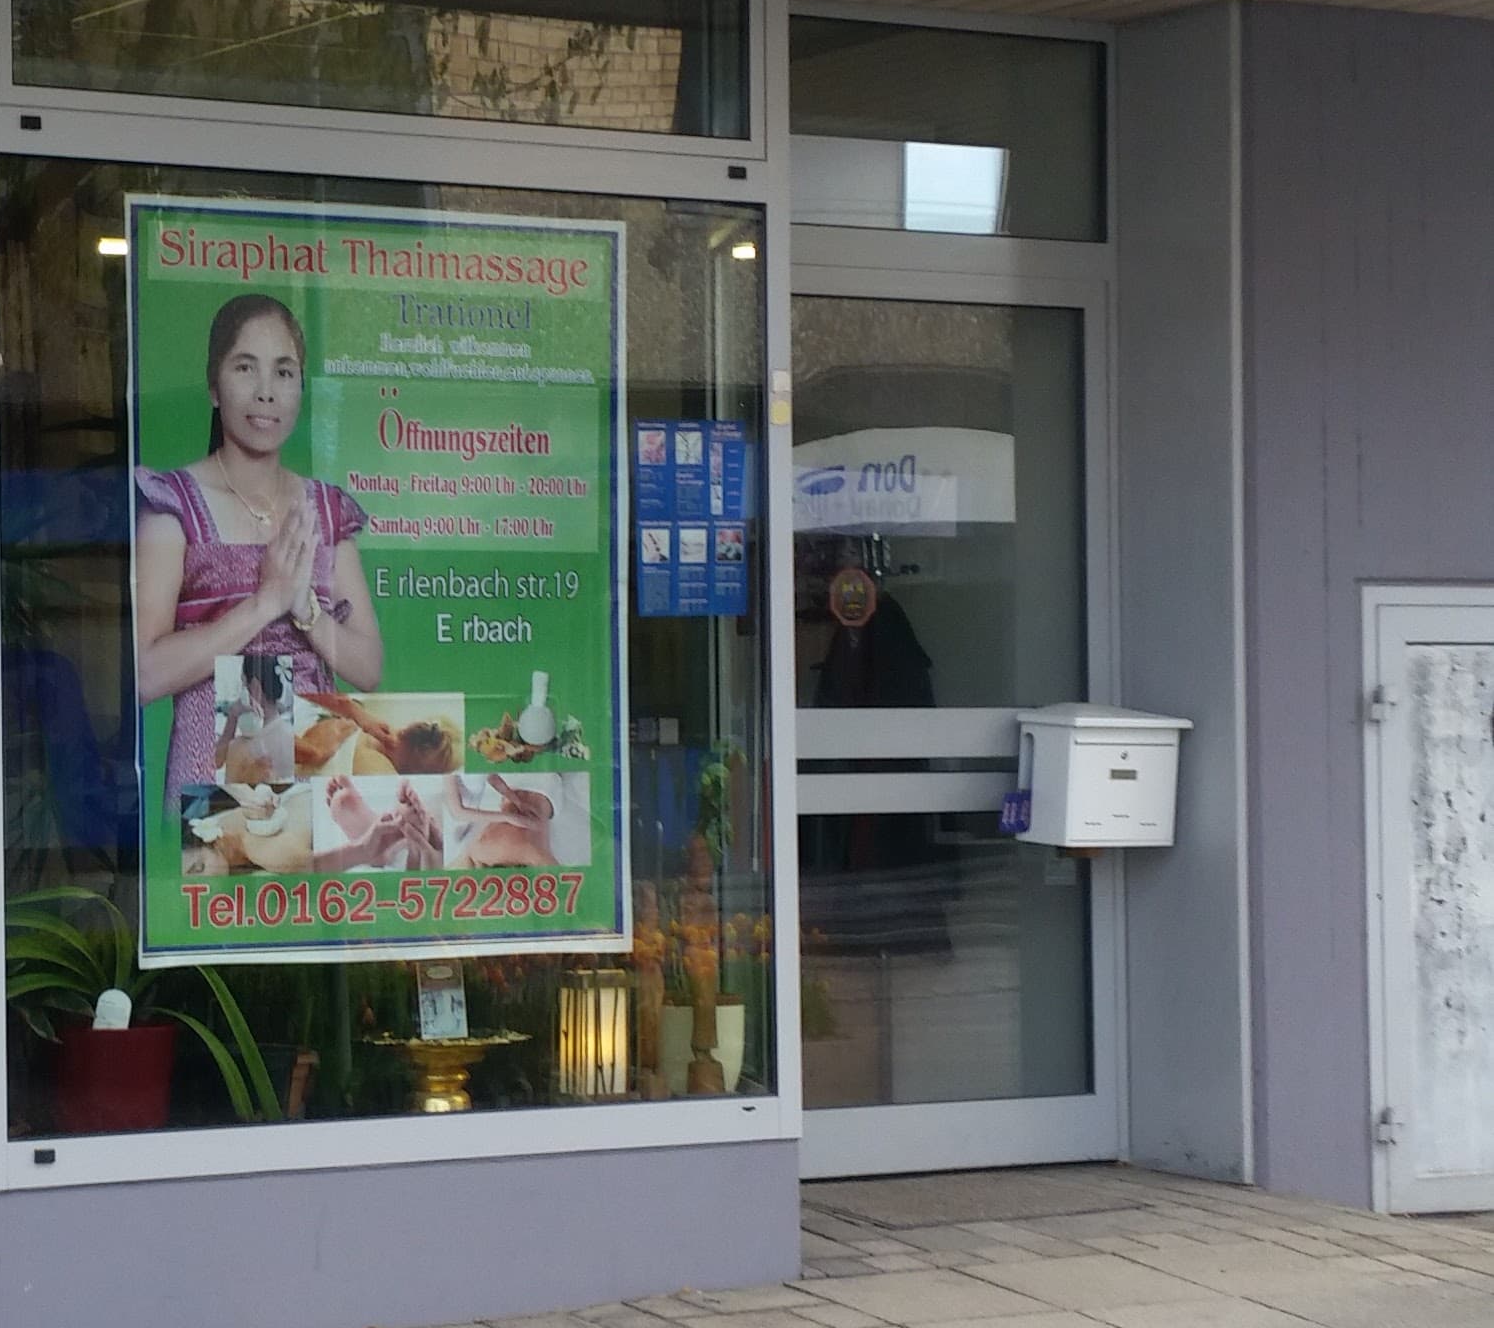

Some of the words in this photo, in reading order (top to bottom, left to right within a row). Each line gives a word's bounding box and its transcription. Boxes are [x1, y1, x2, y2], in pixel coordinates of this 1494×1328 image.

[159, 229, 328, 279] Siraphat
[341, 236, 589, 295] Thaimassage
[377, 385, 551, 461] Öffnungszeiten
[347, 473, 400, 496] Montag
[410, 473, 457, 498] Freitag
[461, 475, 491, 494] 9:00
[494, 475, 516, 495] Uhr
[528, 476, 564, 496] 20:00
[567, 478, 588, 497] Uhr
[369, 515, 420, 541] Samtag
[423, 517, 455, 536] 9:00
[458, 517, 481, 536] Uhr
[494, 518, 530, 537] 17:00
[533, 518, 555, 538] Uhr
